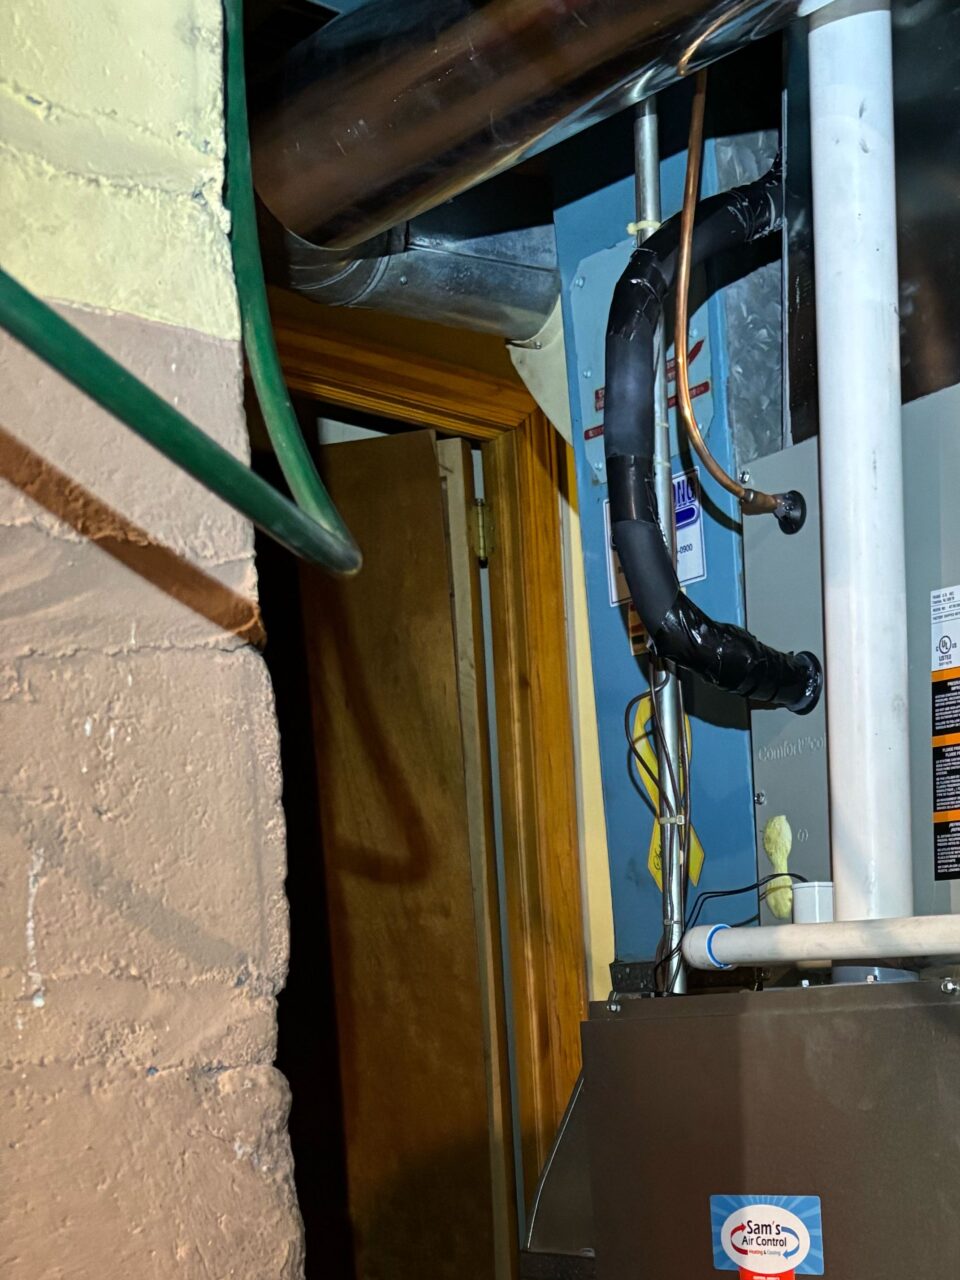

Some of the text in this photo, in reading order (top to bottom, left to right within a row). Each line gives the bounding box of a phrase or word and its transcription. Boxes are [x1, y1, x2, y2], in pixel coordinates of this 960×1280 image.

[938, 654, 952, 662] LISTED
[746, 1220, 780, 1235] Sam's
[742, 1236, 787, 1247] Air Control
